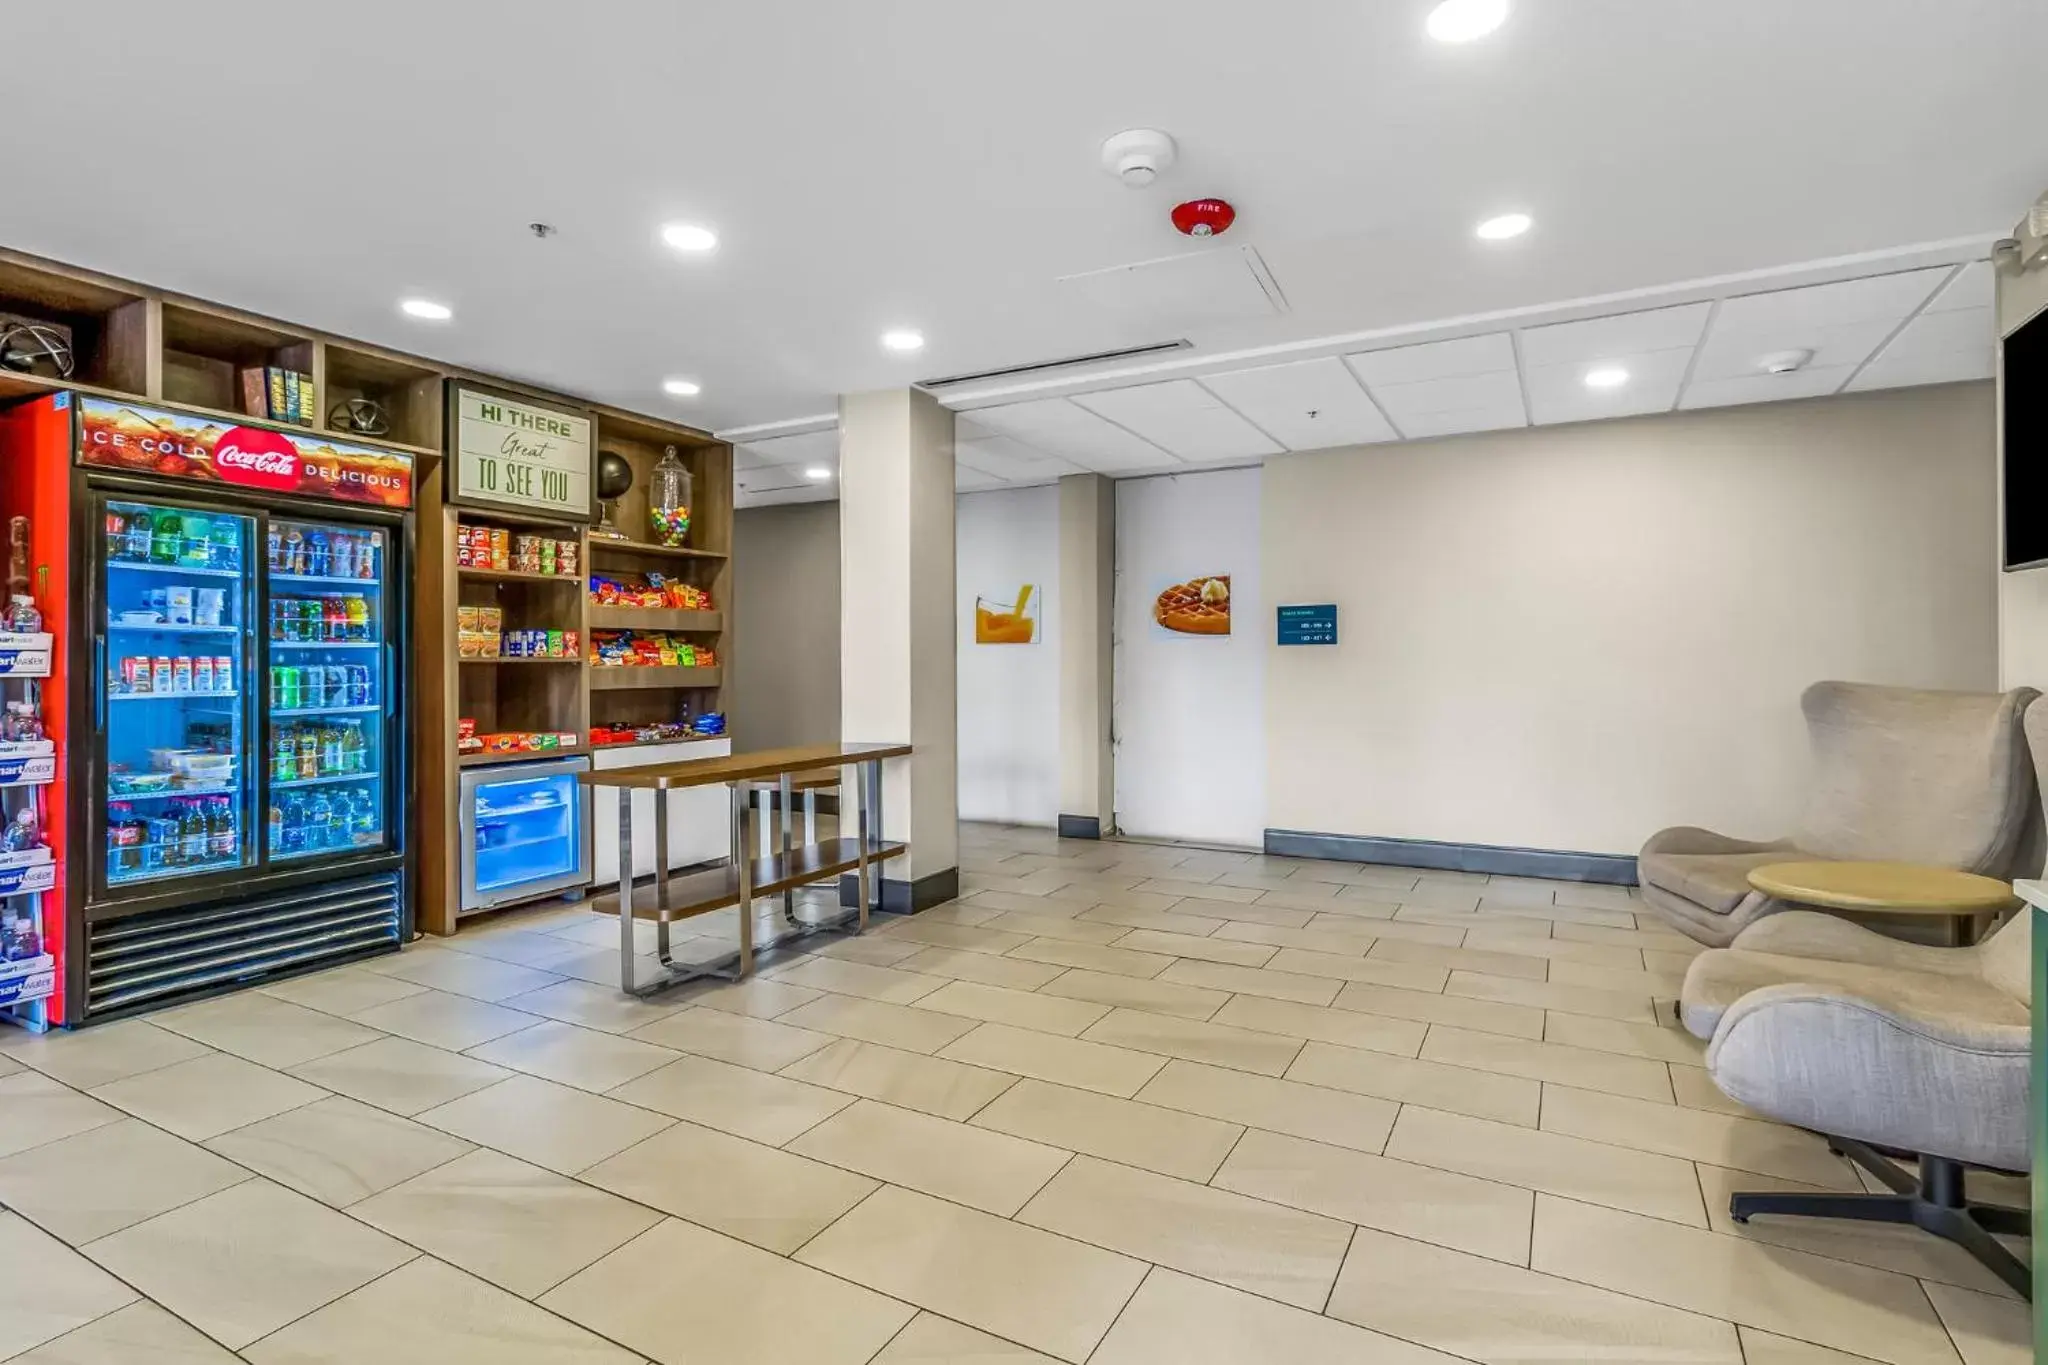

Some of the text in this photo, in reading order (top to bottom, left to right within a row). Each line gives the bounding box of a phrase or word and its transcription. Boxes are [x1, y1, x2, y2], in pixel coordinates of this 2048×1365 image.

[1197, 204, 1221, 212] FIRE
[481, 403, 571, 437] HI THERE
[82, 429, 207, 457] ICE COLD
[500, 431, 558, 460] Great
[217, 444, 297, 476] Coca-Cola
[305, 464, 401, 489] DELICIOUS
[479, 457, 568, 501] TO SEE YOU
